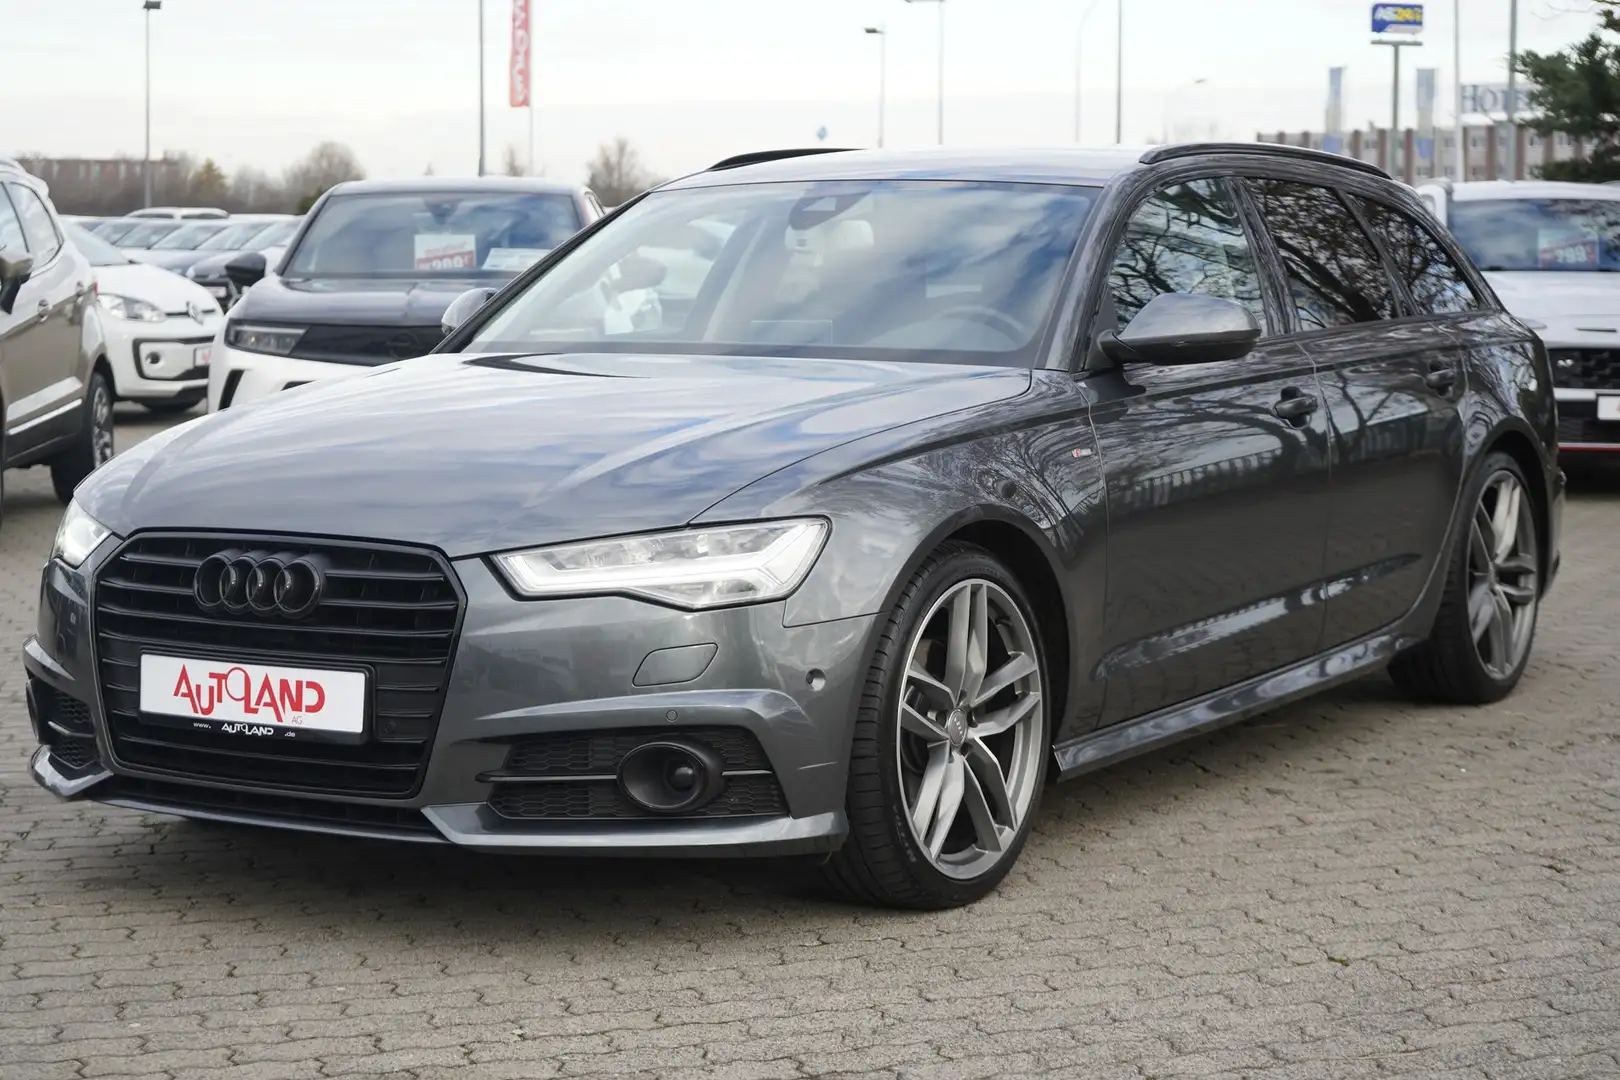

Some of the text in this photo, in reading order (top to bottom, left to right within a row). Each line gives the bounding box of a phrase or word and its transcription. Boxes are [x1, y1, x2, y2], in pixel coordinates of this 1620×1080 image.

[173, 664, 325, 722] AUTOLAND
[292, 715, 303, 725] AG
[221, 723, 274, 736] AUTOLAND
